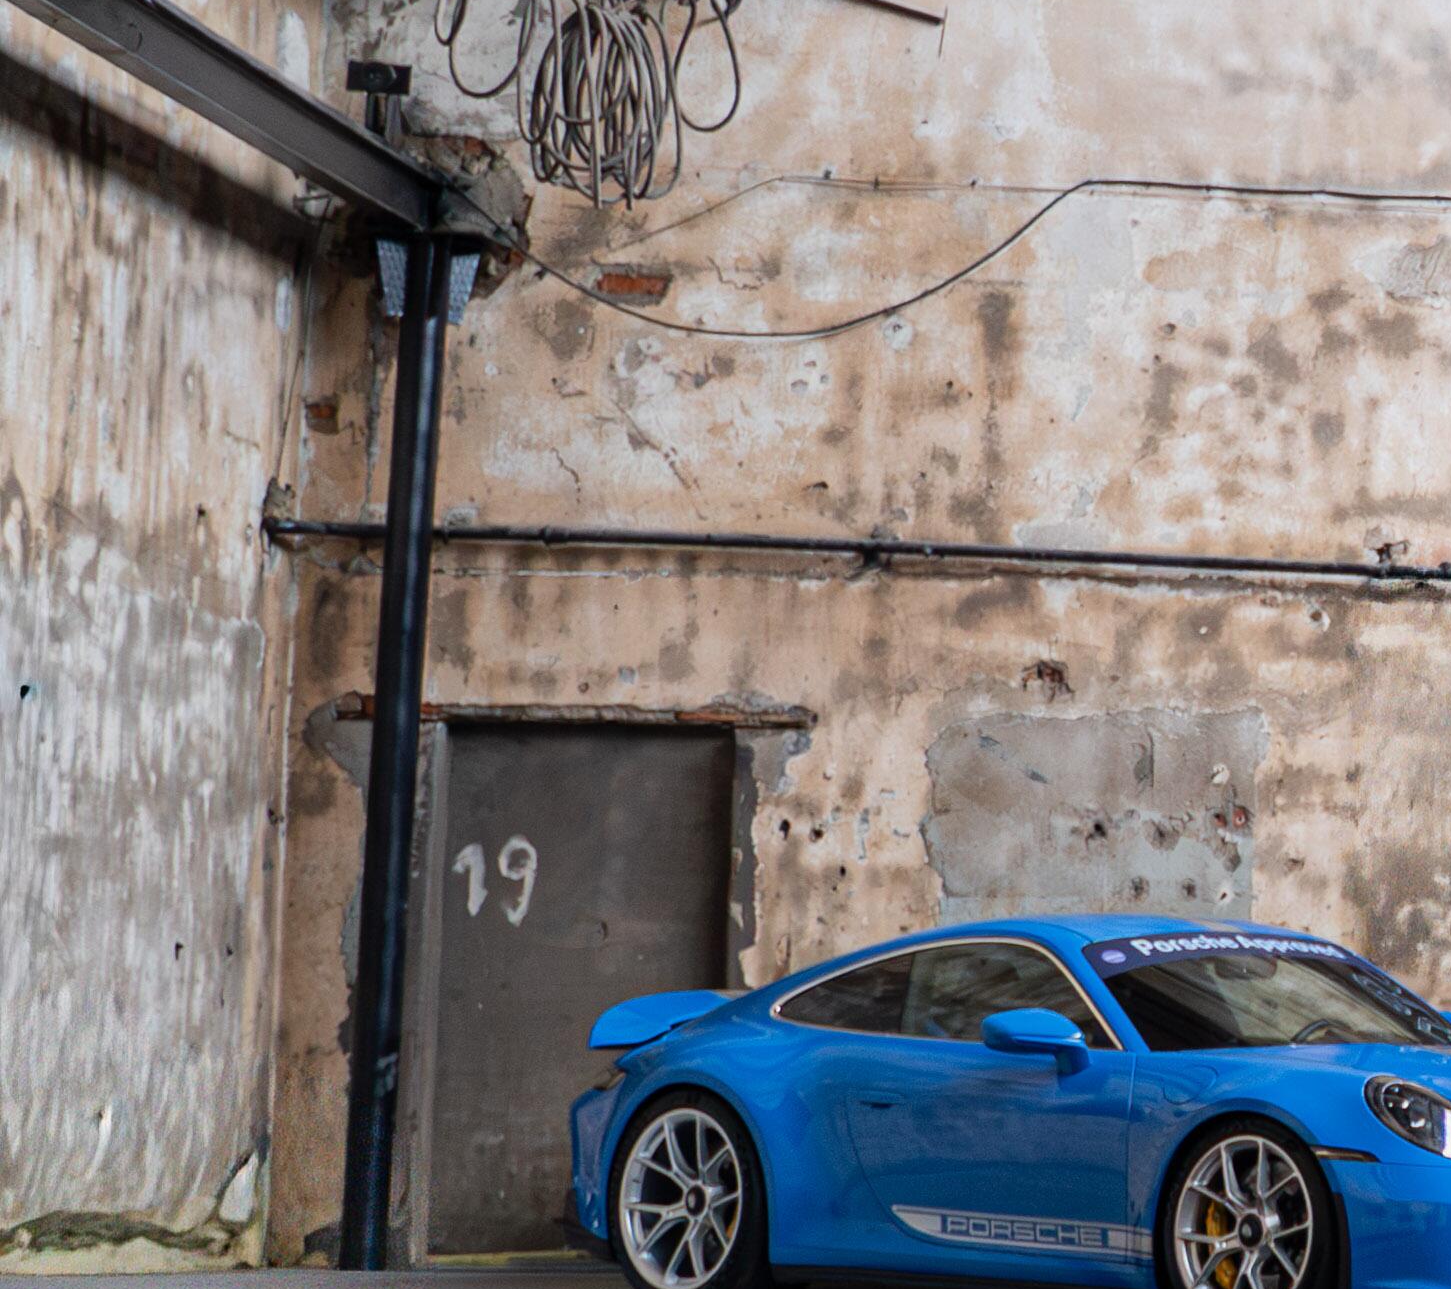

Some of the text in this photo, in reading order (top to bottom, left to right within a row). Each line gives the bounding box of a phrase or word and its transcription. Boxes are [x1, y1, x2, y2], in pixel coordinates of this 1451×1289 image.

[452, 835, 538, 927] 19
[1131, 934, 1239, 956] Porsche
[946, 1216, 1102, 1246] PORSCHE
